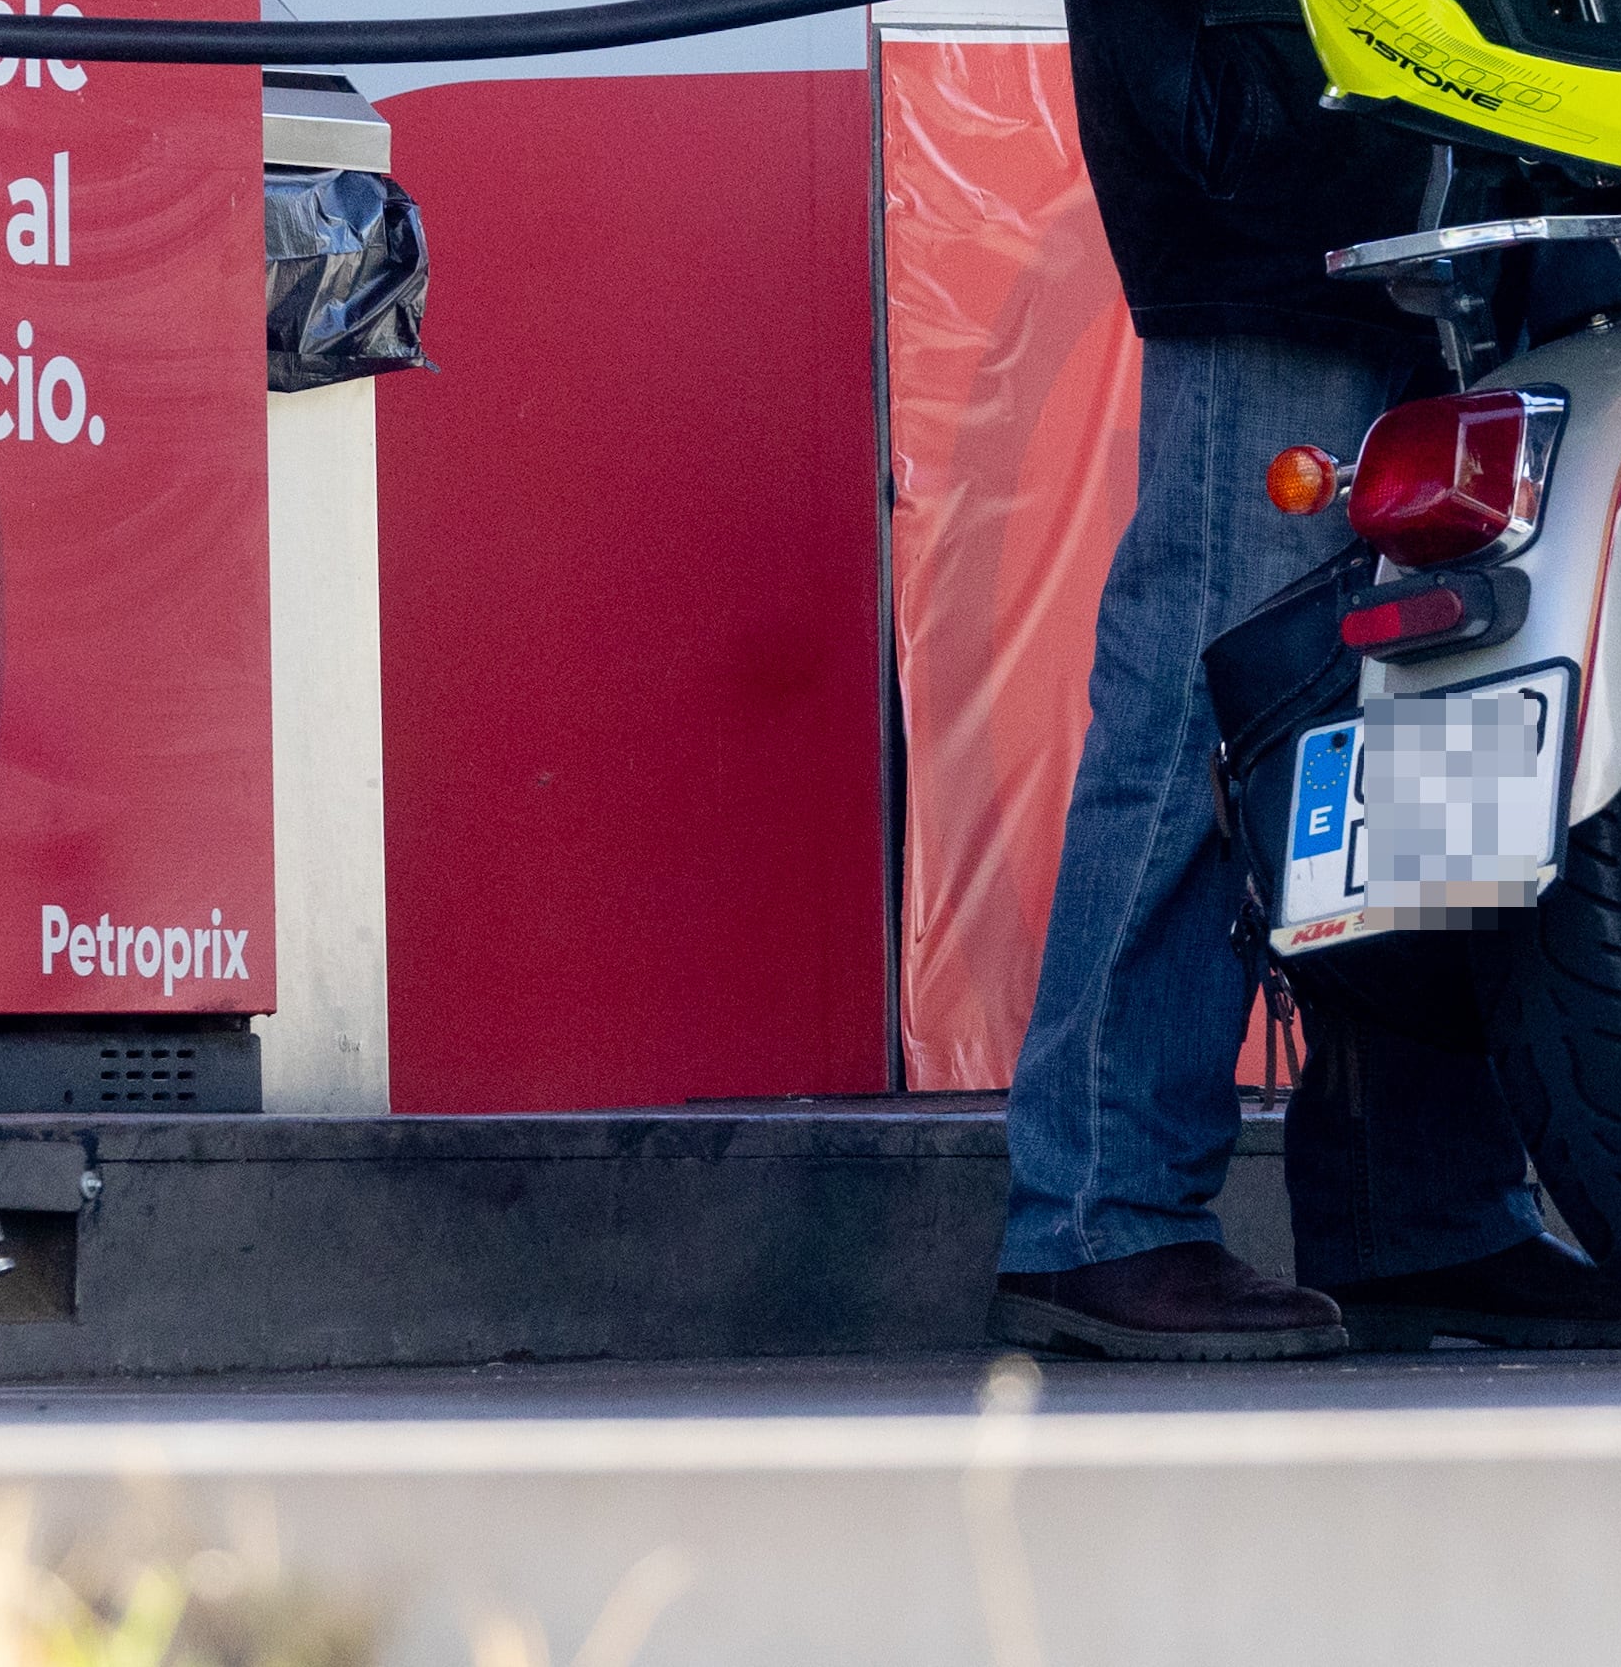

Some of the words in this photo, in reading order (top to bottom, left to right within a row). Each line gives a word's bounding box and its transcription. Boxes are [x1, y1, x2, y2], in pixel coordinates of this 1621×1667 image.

[1347, 26, 1504, 112] ASTONE
[1394, 32, 1563, 113] 800
[5, 150, 70, 266] al
[1308, 804, 1334, 836] E
[40, 904, 250, 997] Petroprix
[1290, 919, 1348, 946] KTM
